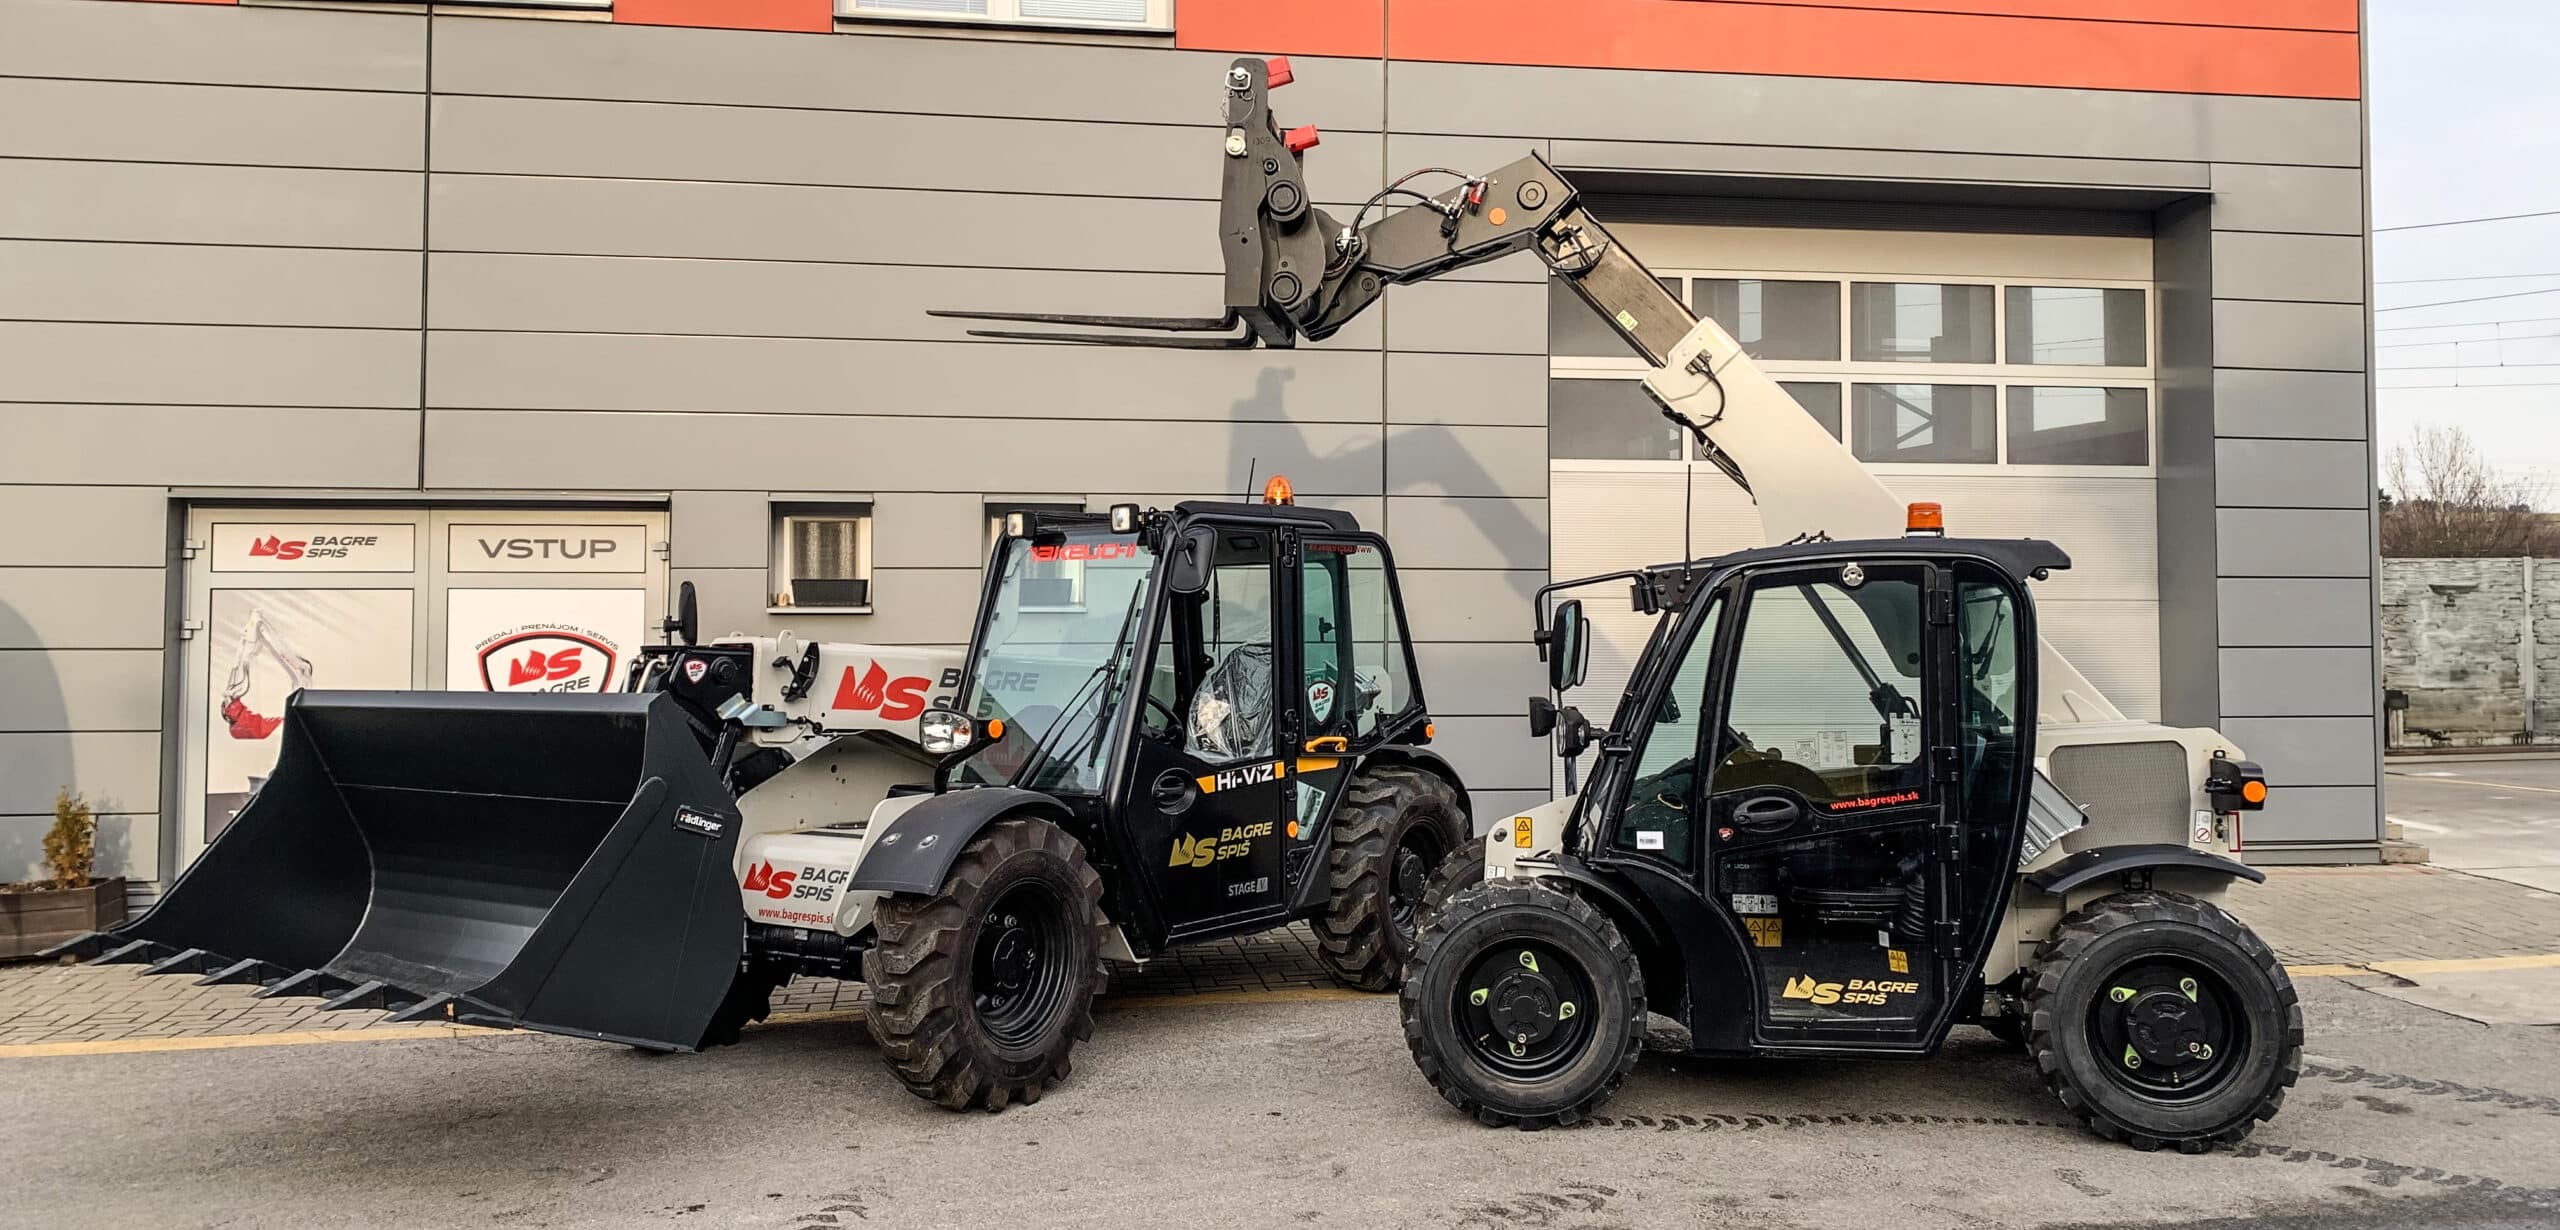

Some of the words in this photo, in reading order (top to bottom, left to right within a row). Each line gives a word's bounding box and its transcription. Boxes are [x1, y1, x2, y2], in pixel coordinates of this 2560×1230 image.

[312, 536, 378, 546] BAGRE
[477, 538, 617, 559] VSTUP
[306, 546, 349, 558] SPIŠ
[475, 629, 513, 650] PREDAJ
[586, 630, 619, 650] SERVIS
[938, 667, 1040, 692] BGRE
[1830, 791, 1919, 810] www.bagrespis.sk
[1221, 821, 1274, 842] BAGRE
[1216, 840, 1251, 861] SPIŠ
[800, 867, 850, 885] BAGR
[793, 884, 834, 902] SPIŠ
[1228, 880, 1256, 896] STAGE
[1847, 979, 1919, 994] BAGRE
[1841, 991, 1888, 1005] SPIŠ
